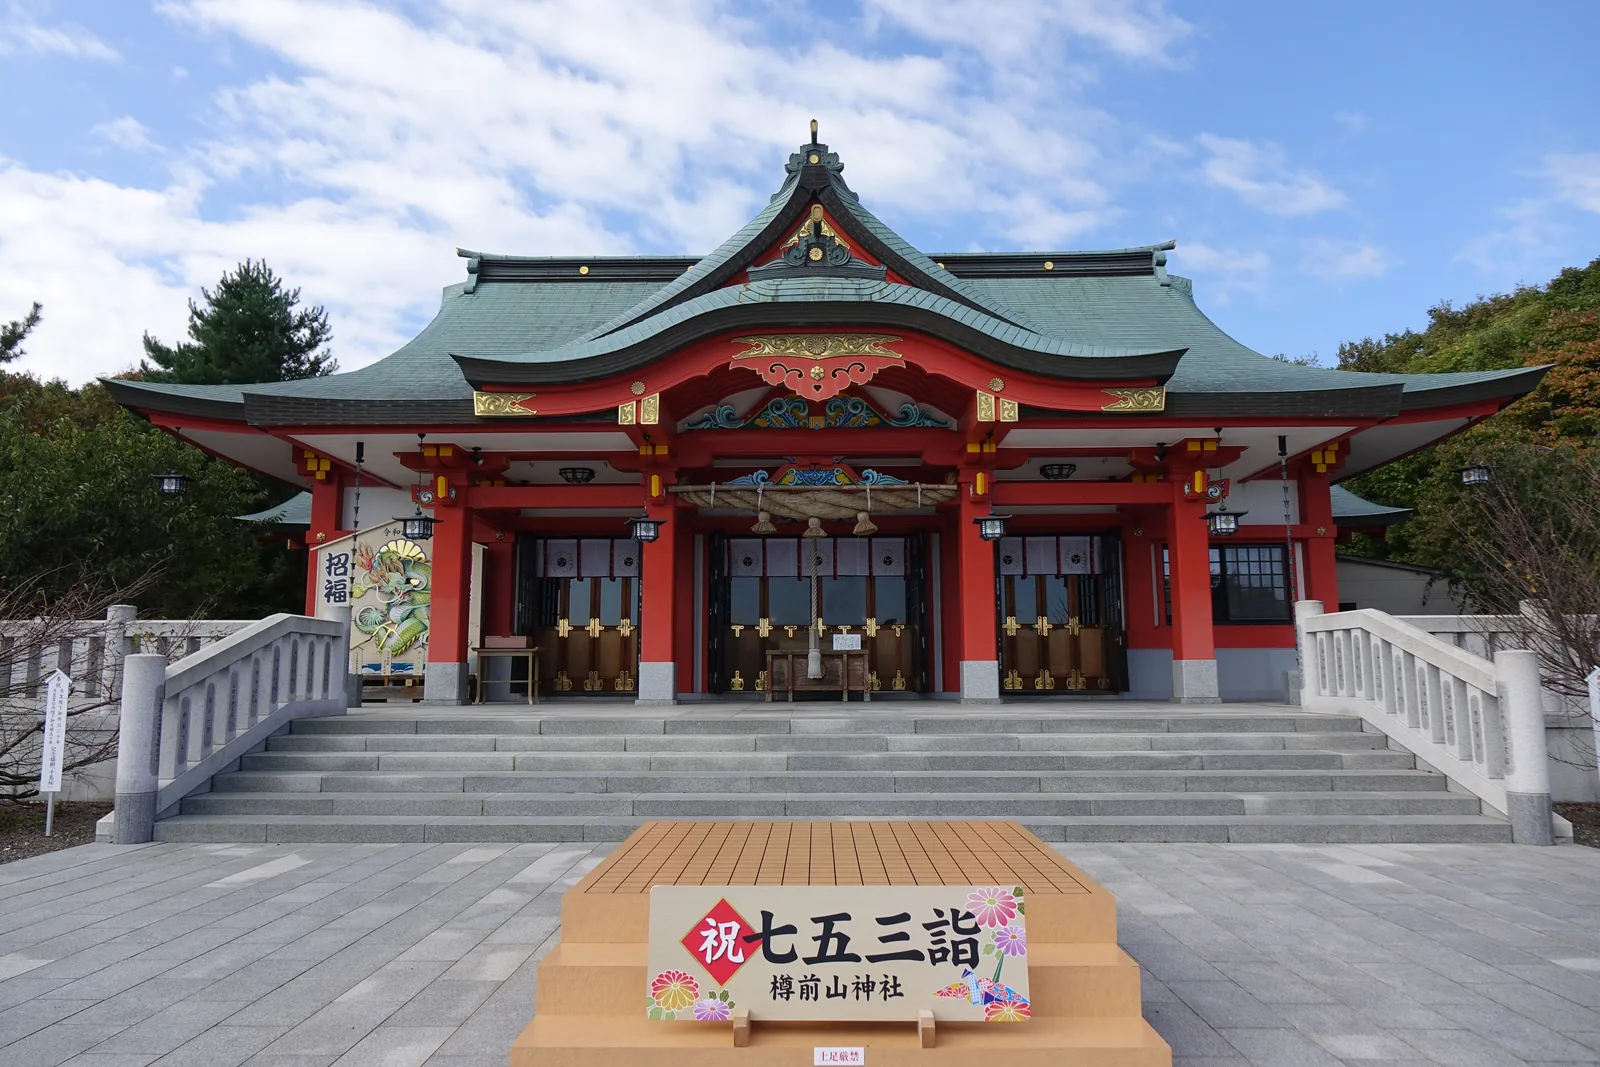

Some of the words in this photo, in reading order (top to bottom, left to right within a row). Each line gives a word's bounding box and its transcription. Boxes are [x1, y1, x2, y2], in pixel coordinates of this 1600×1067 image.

[324, 552, 350, 604] 招福
[699, 917, 745, 964] 祝
[742, 908, 982, 970] 七五三詣
[769, 974, 905, 1002] 樽前山神社
[818, 1050, 860, 1062] 土足厳禁
